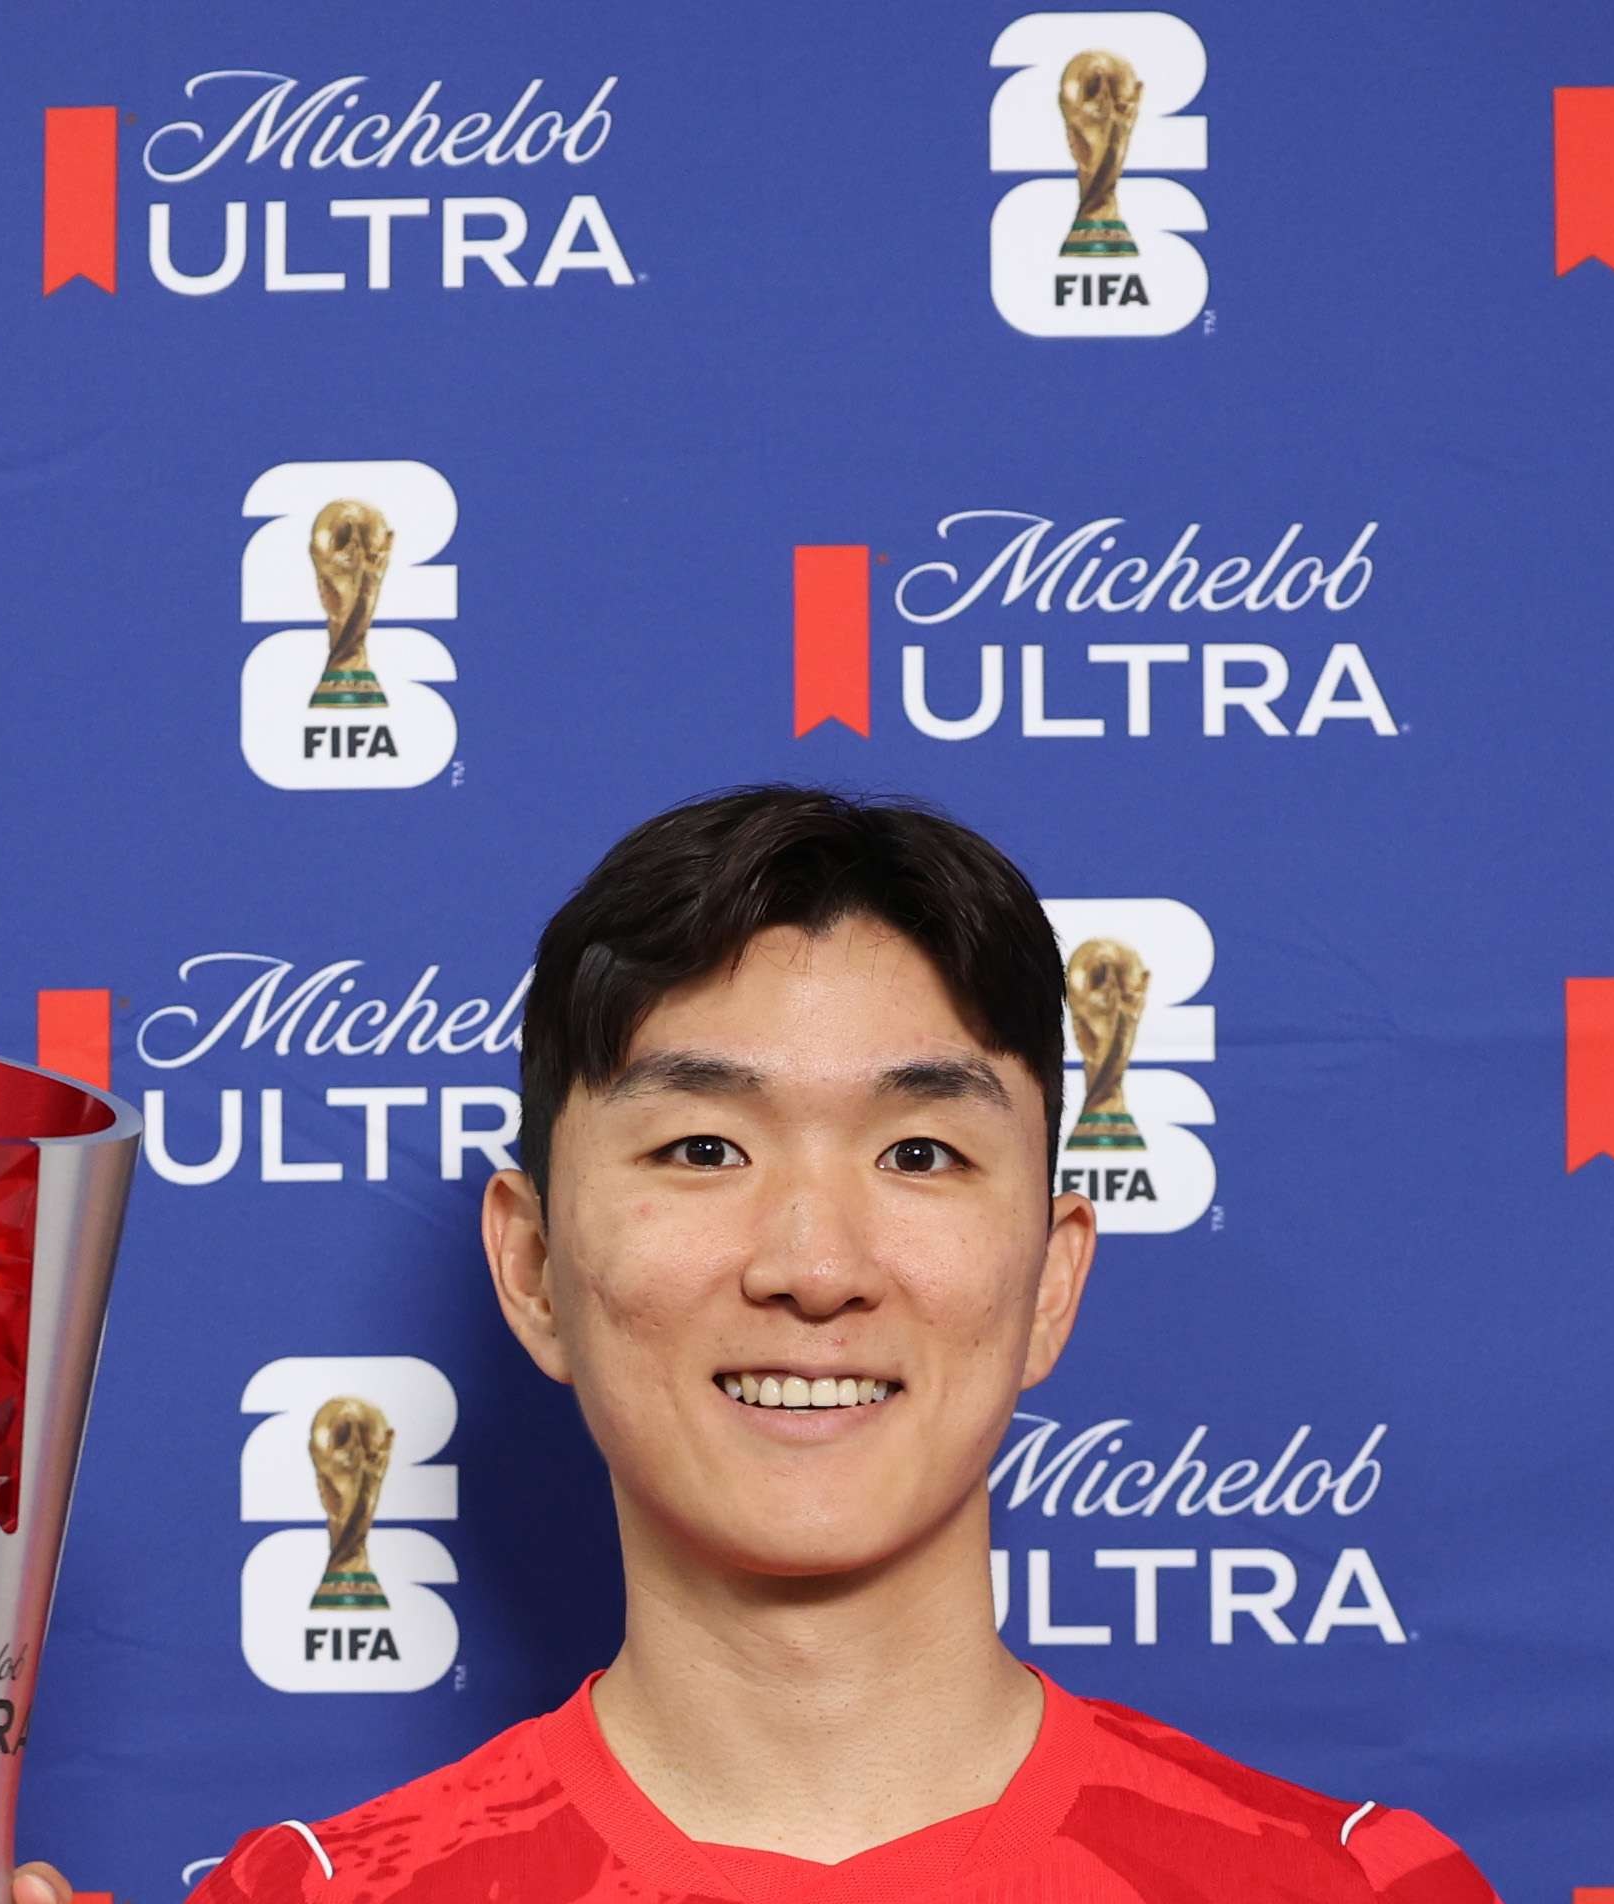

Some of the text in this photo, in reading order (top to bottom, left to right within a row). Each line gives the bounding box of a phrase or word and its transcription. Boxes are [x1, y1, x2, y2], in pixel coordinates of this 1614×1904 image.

[142, 70, 619, 184] Michelob
[148, 195, 636, 297] ULTRA
[1055, 274, 1149, 307] FIFA
[894, 509, 1379, 625] Michelob
[902, 643, 1399, 742] ULTRA
[304, 725, 398, 759] FIFA
[136, 952, 536, 1069] Michel
[1060, 1168, 1159, 1201] FIFA
[305, 1628, 400, 1661] FIFA
[989, 1548, 1407, 1646] LTRA
